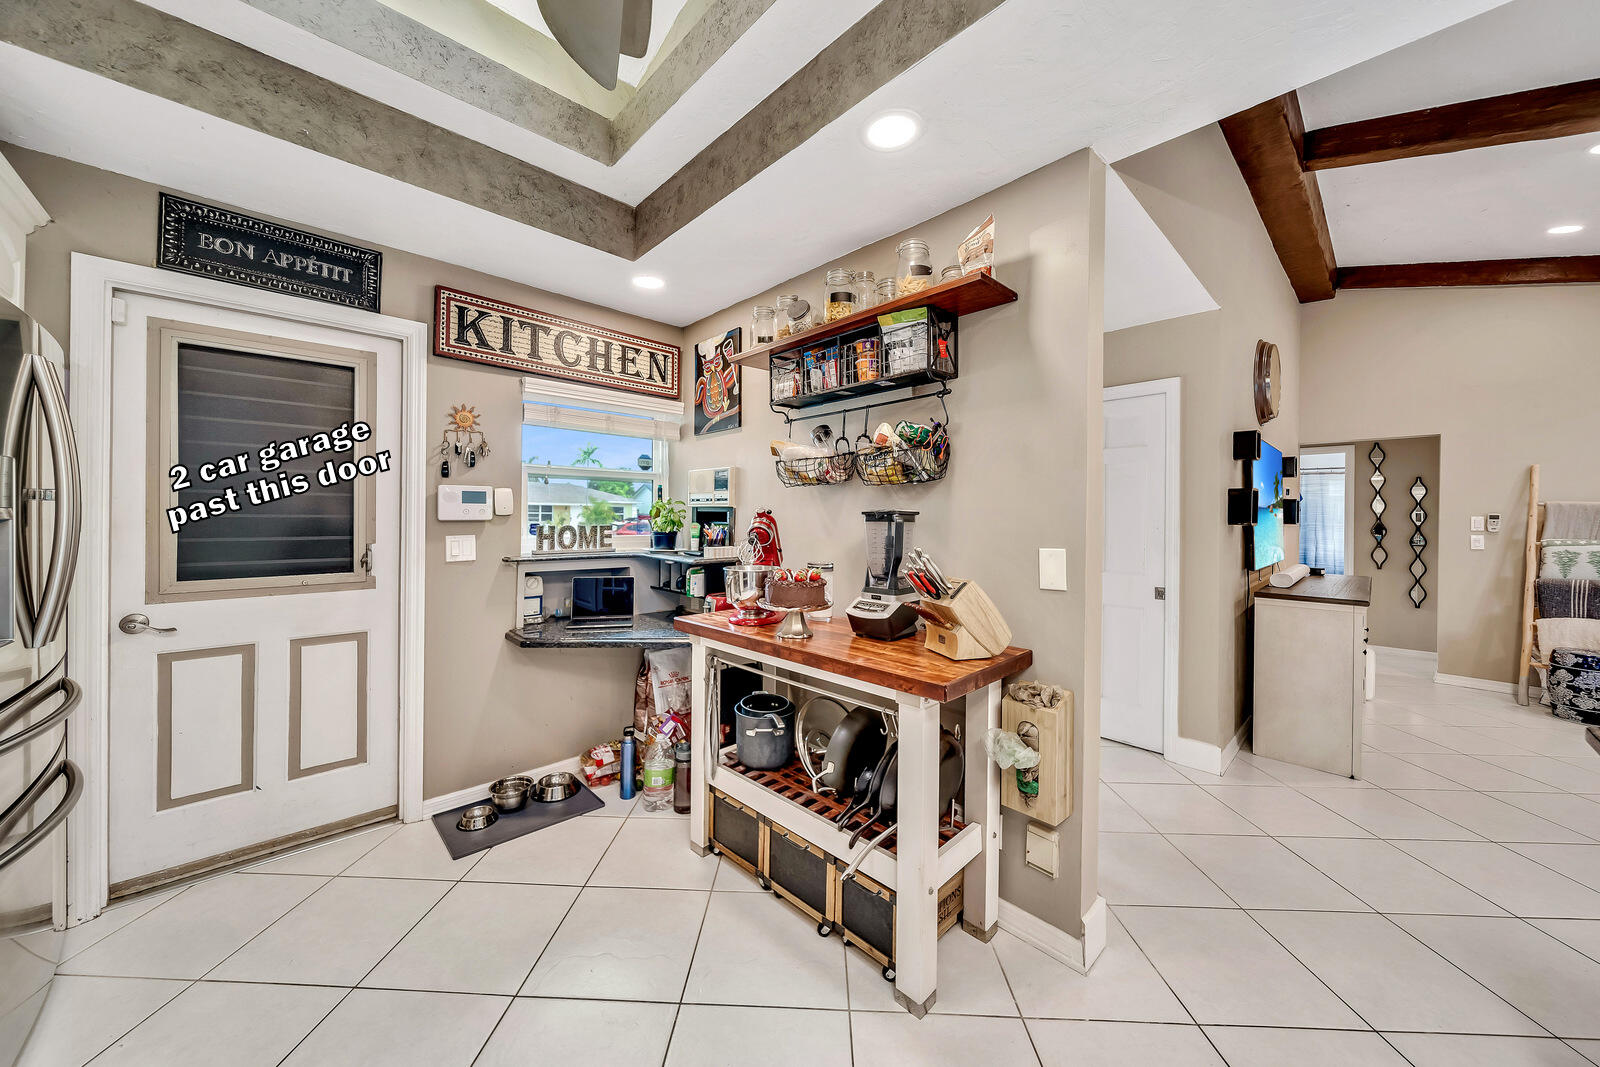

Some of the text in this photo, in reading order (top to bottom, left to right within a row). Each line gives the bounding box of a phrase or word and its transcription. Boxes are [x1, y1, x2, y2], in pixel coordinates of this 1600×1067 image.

[198, 232, 353, 283] BON APPÉTIT
[453, 304, 670, 385] KITCHEN
[536, 524, 613, 551] HOME
